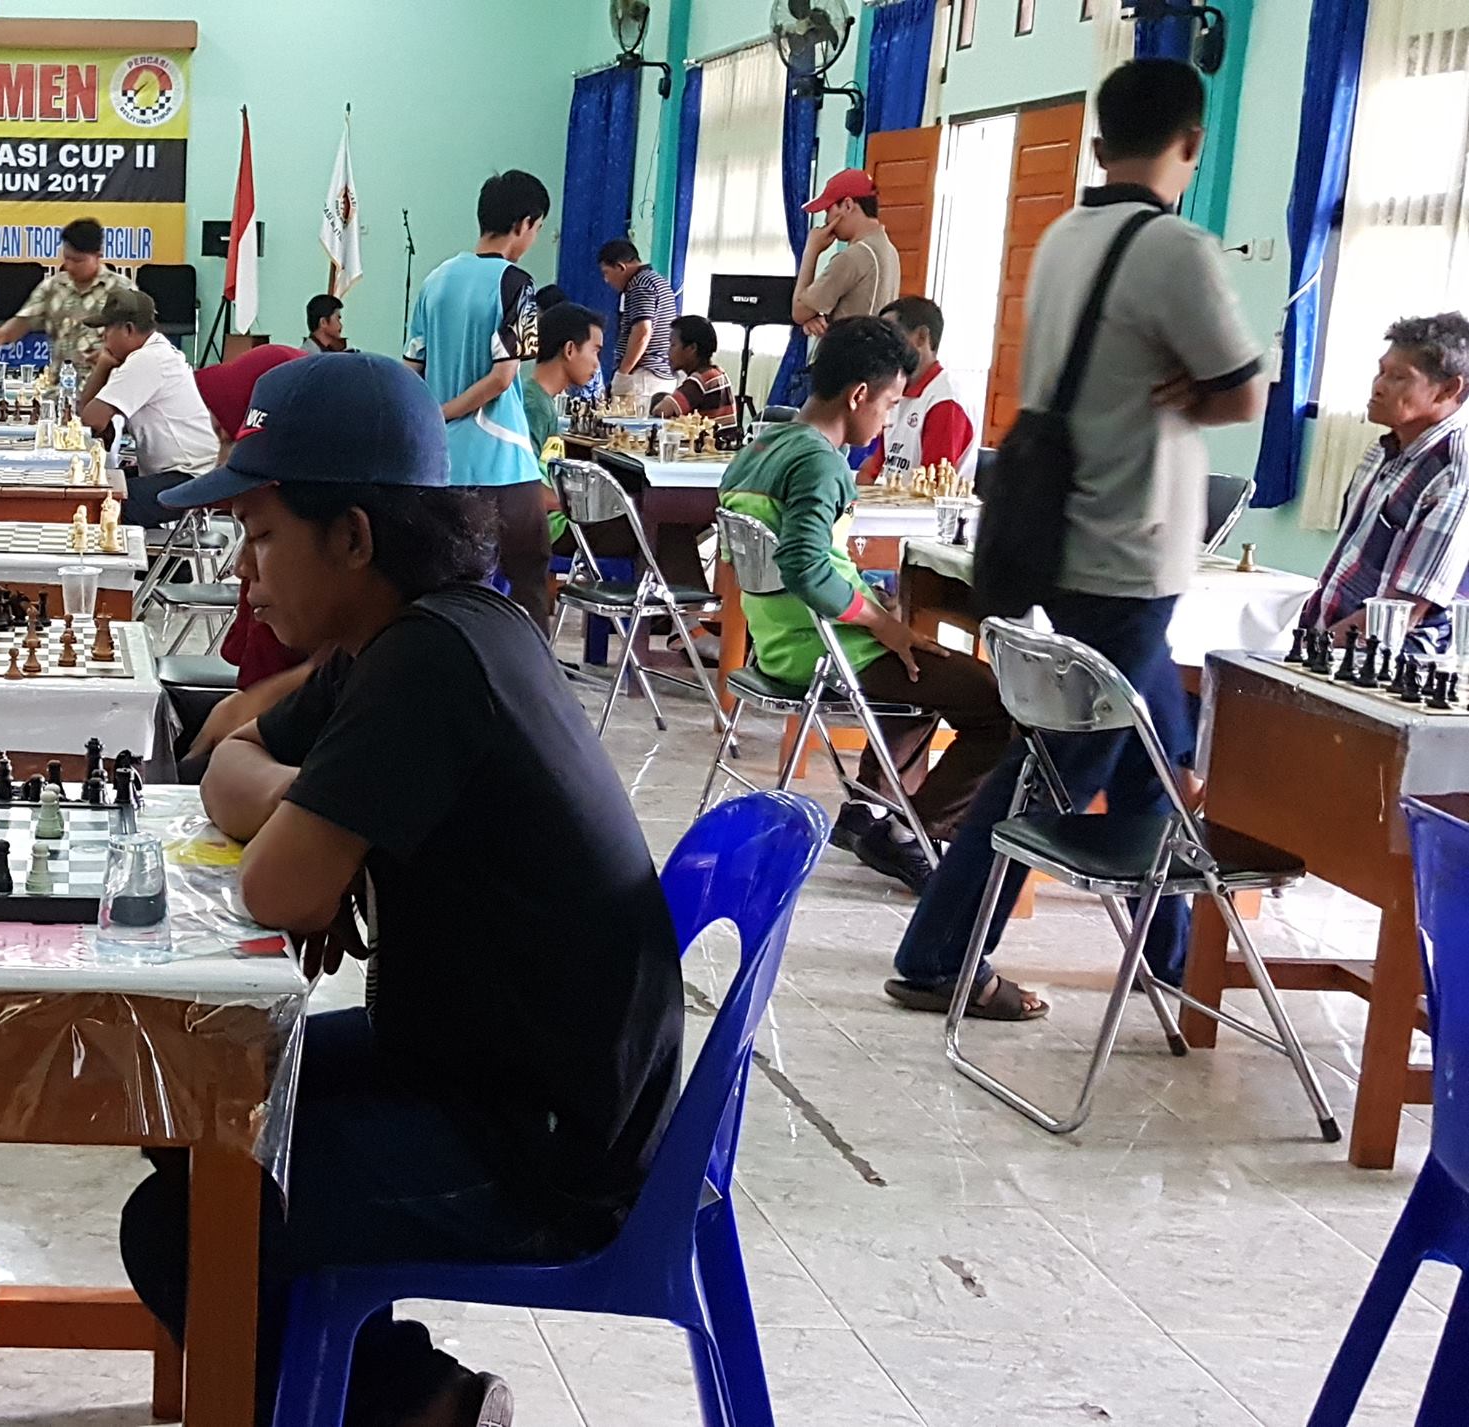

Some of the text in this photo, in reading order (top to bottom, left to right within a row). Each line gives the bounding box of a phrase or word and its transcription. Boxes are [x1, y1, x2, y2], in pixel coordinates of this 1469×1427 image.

[126, 55, 170, 69] PERCASI
[119, 105, 173, 125] BELITUNG TIMUR
[58, 143, 126, 169] CUP
[134, 144, 157, 169] II
[47, 173, 108, 193] 2017
[24, 226, 64, 258] TROP
[98, 227, 153, 259] RGILIR
[33, 341, 49, 361] 22
